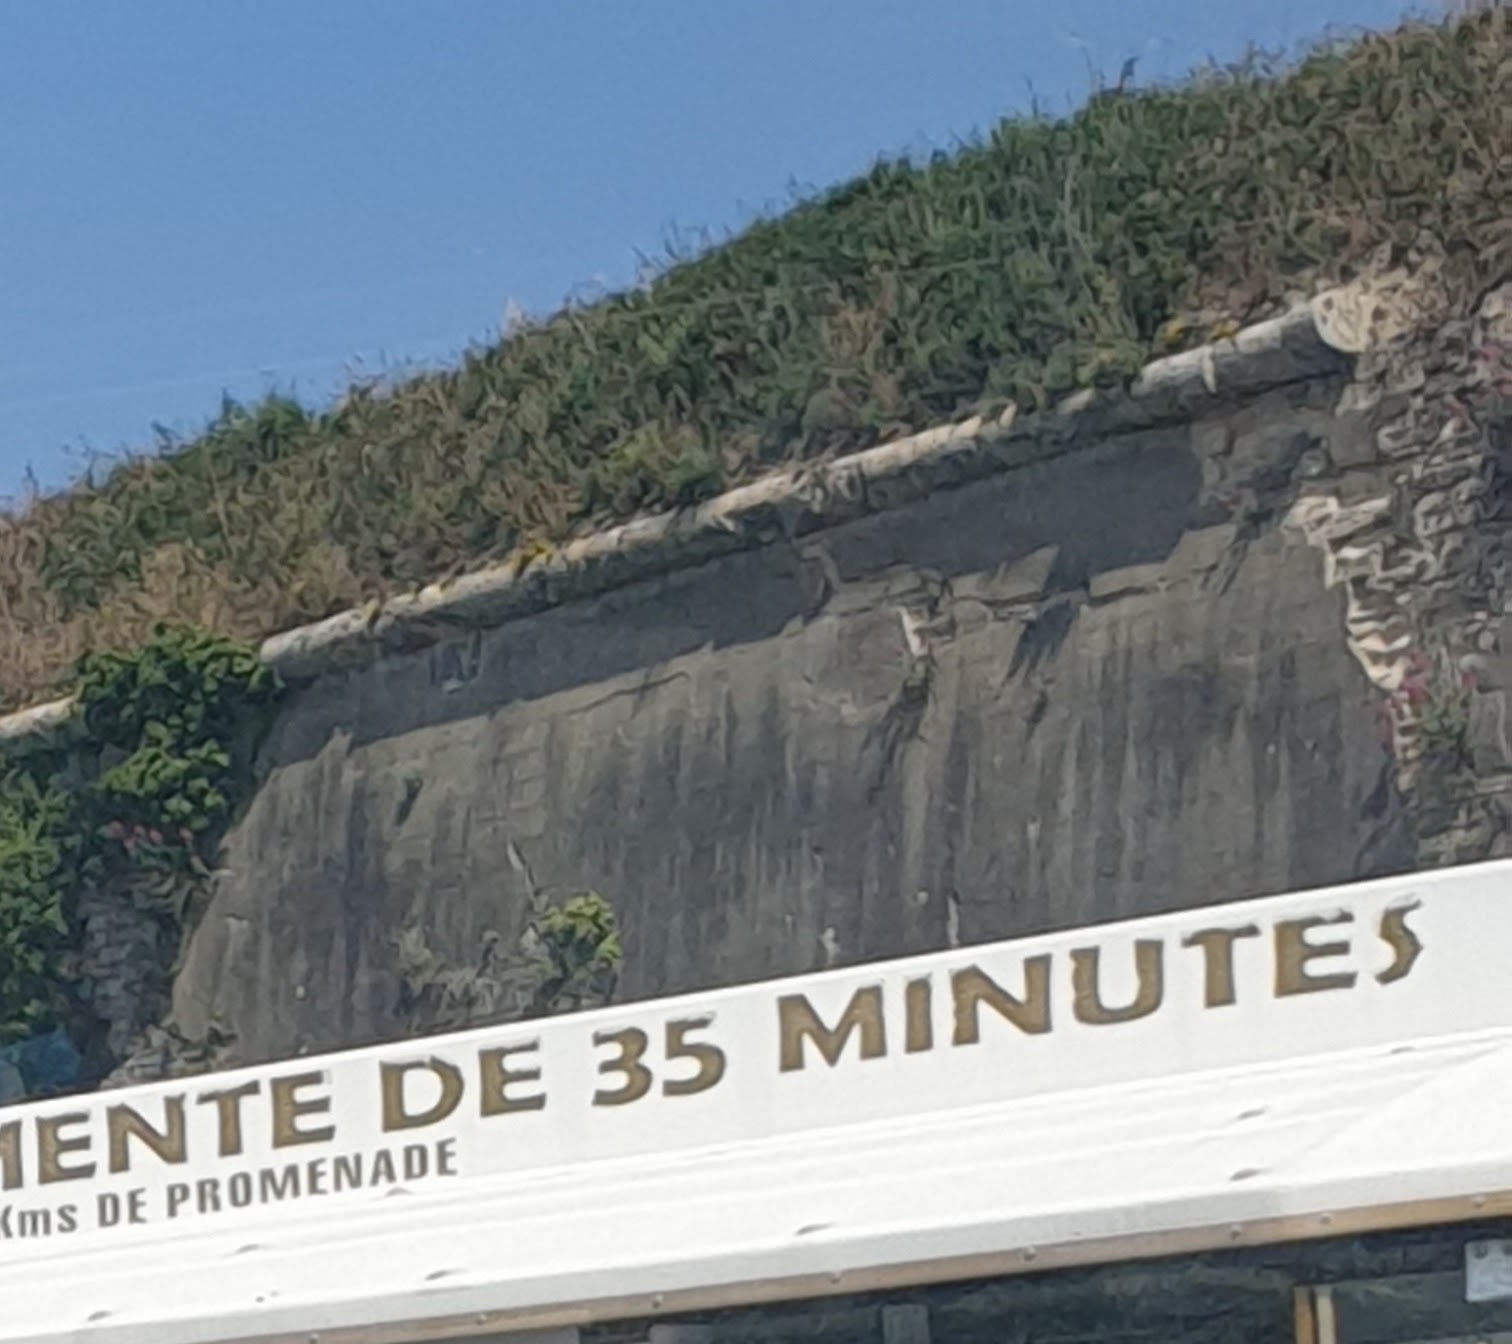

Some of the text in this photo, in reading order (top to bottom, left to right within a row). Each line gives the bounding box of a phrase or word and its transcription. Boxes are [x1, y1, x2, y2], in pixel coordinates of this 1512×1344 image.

[380, 1040, 547, 1133] DE
[592, 1014, 727, 1107] 35
[777, 897, 1423, 1073] MINUTES
[98, 1187, 148, 1228] DE
[167, 1138, 457, 1218] PROMENADE
